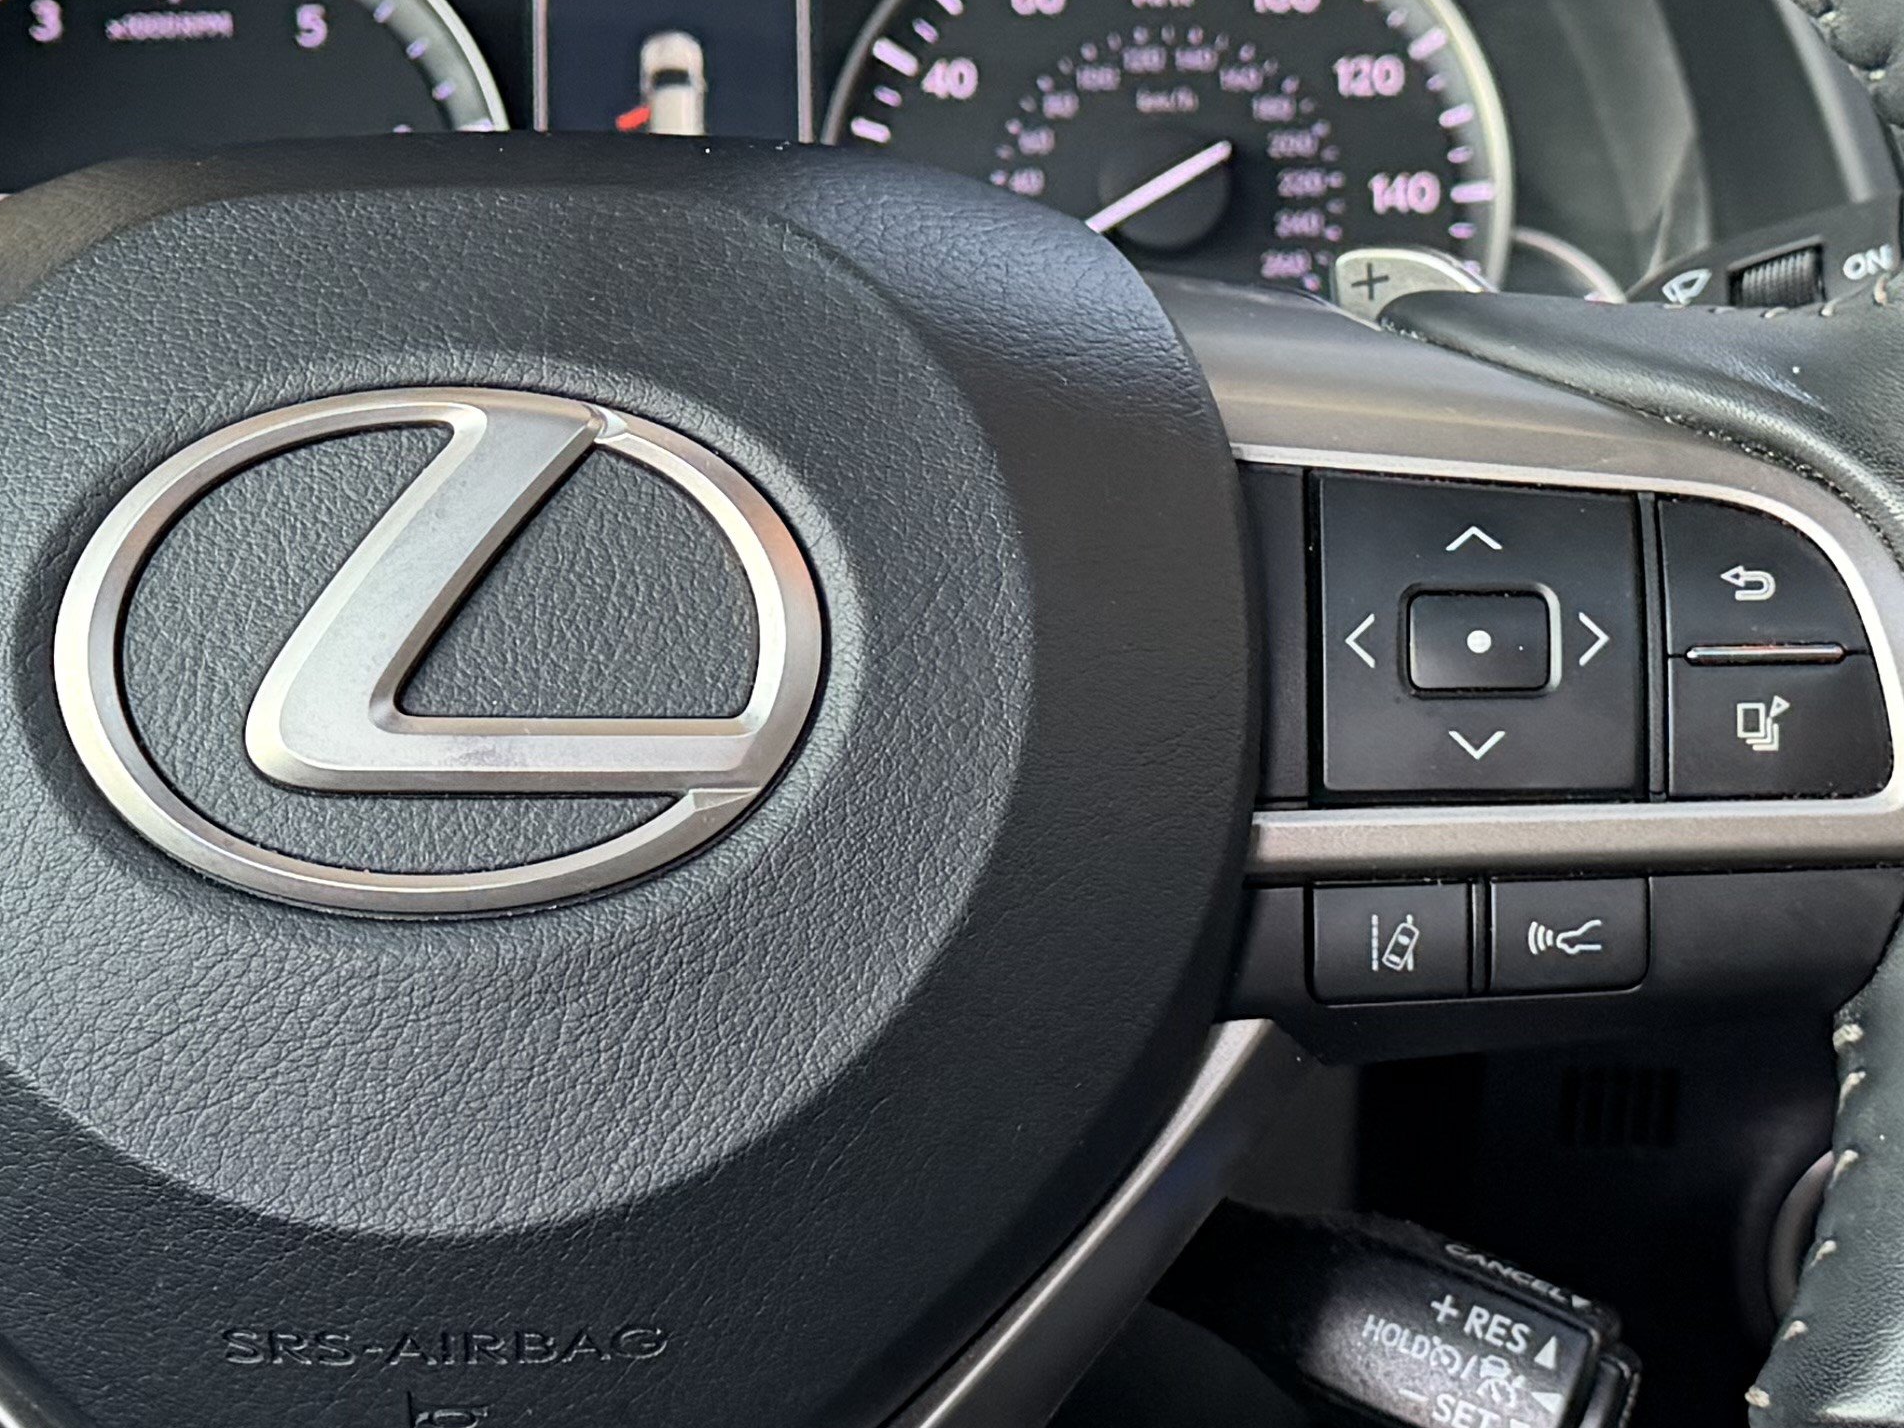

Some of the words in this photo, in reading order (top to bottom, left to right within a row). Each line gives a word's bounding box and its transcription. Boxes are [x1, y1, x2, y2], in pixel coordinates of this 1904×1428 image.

[296, 4, 328, 48] 5
[920, 58, 978, 99] 40
[1333, 55, 1405, 97] 120
[1368, 172, 1442, 214] 140
[1445, 1242, 1571, 1304] CANCEL
[222, 1328, 667, 1366] SRS-AIRBAG
[1361, 1314, 1431, 1358] HOLD
[1463, 1304, 1532, 1355] RES
